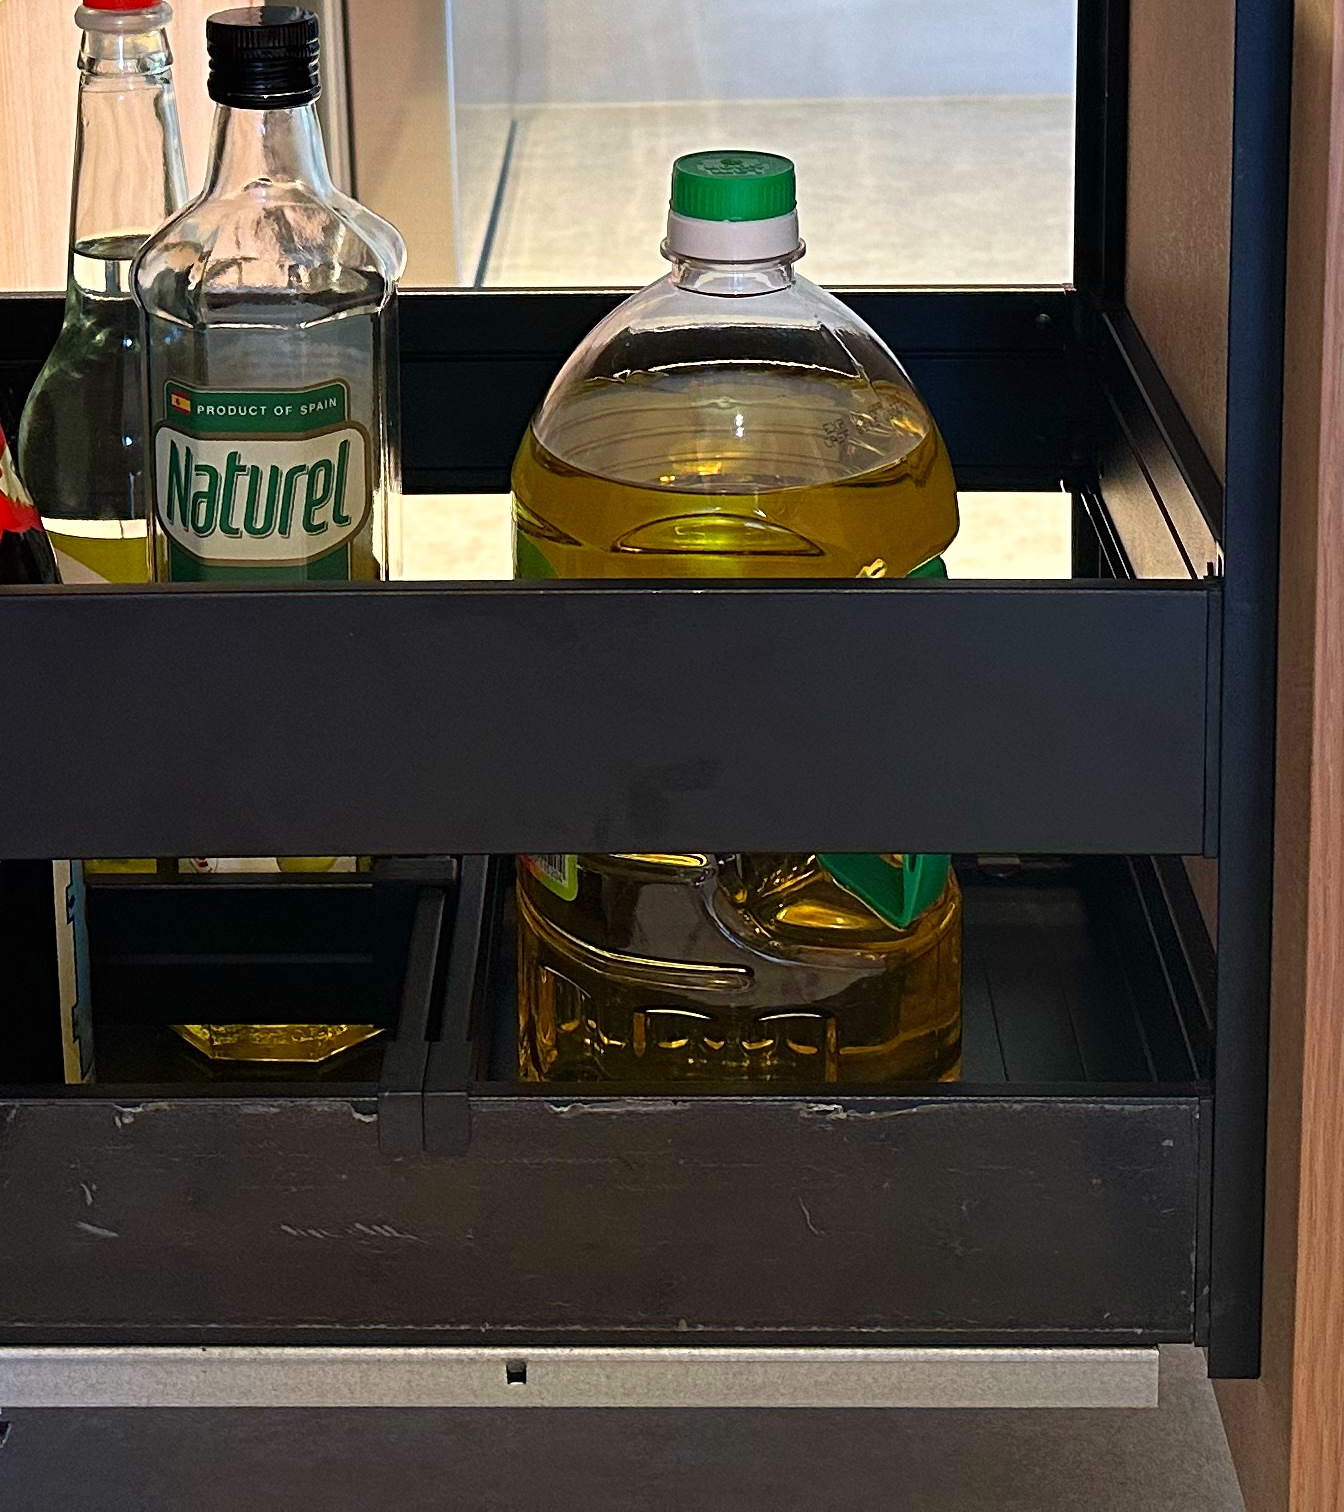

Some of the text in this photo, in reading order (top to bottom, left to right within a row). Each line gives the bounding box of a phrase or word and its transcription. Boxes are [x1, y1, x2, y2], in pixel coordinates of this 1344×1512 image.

[197, 397, 338, 416] PRODUCT OF SPAIN
[166, 438, 351, 538] Naturel
